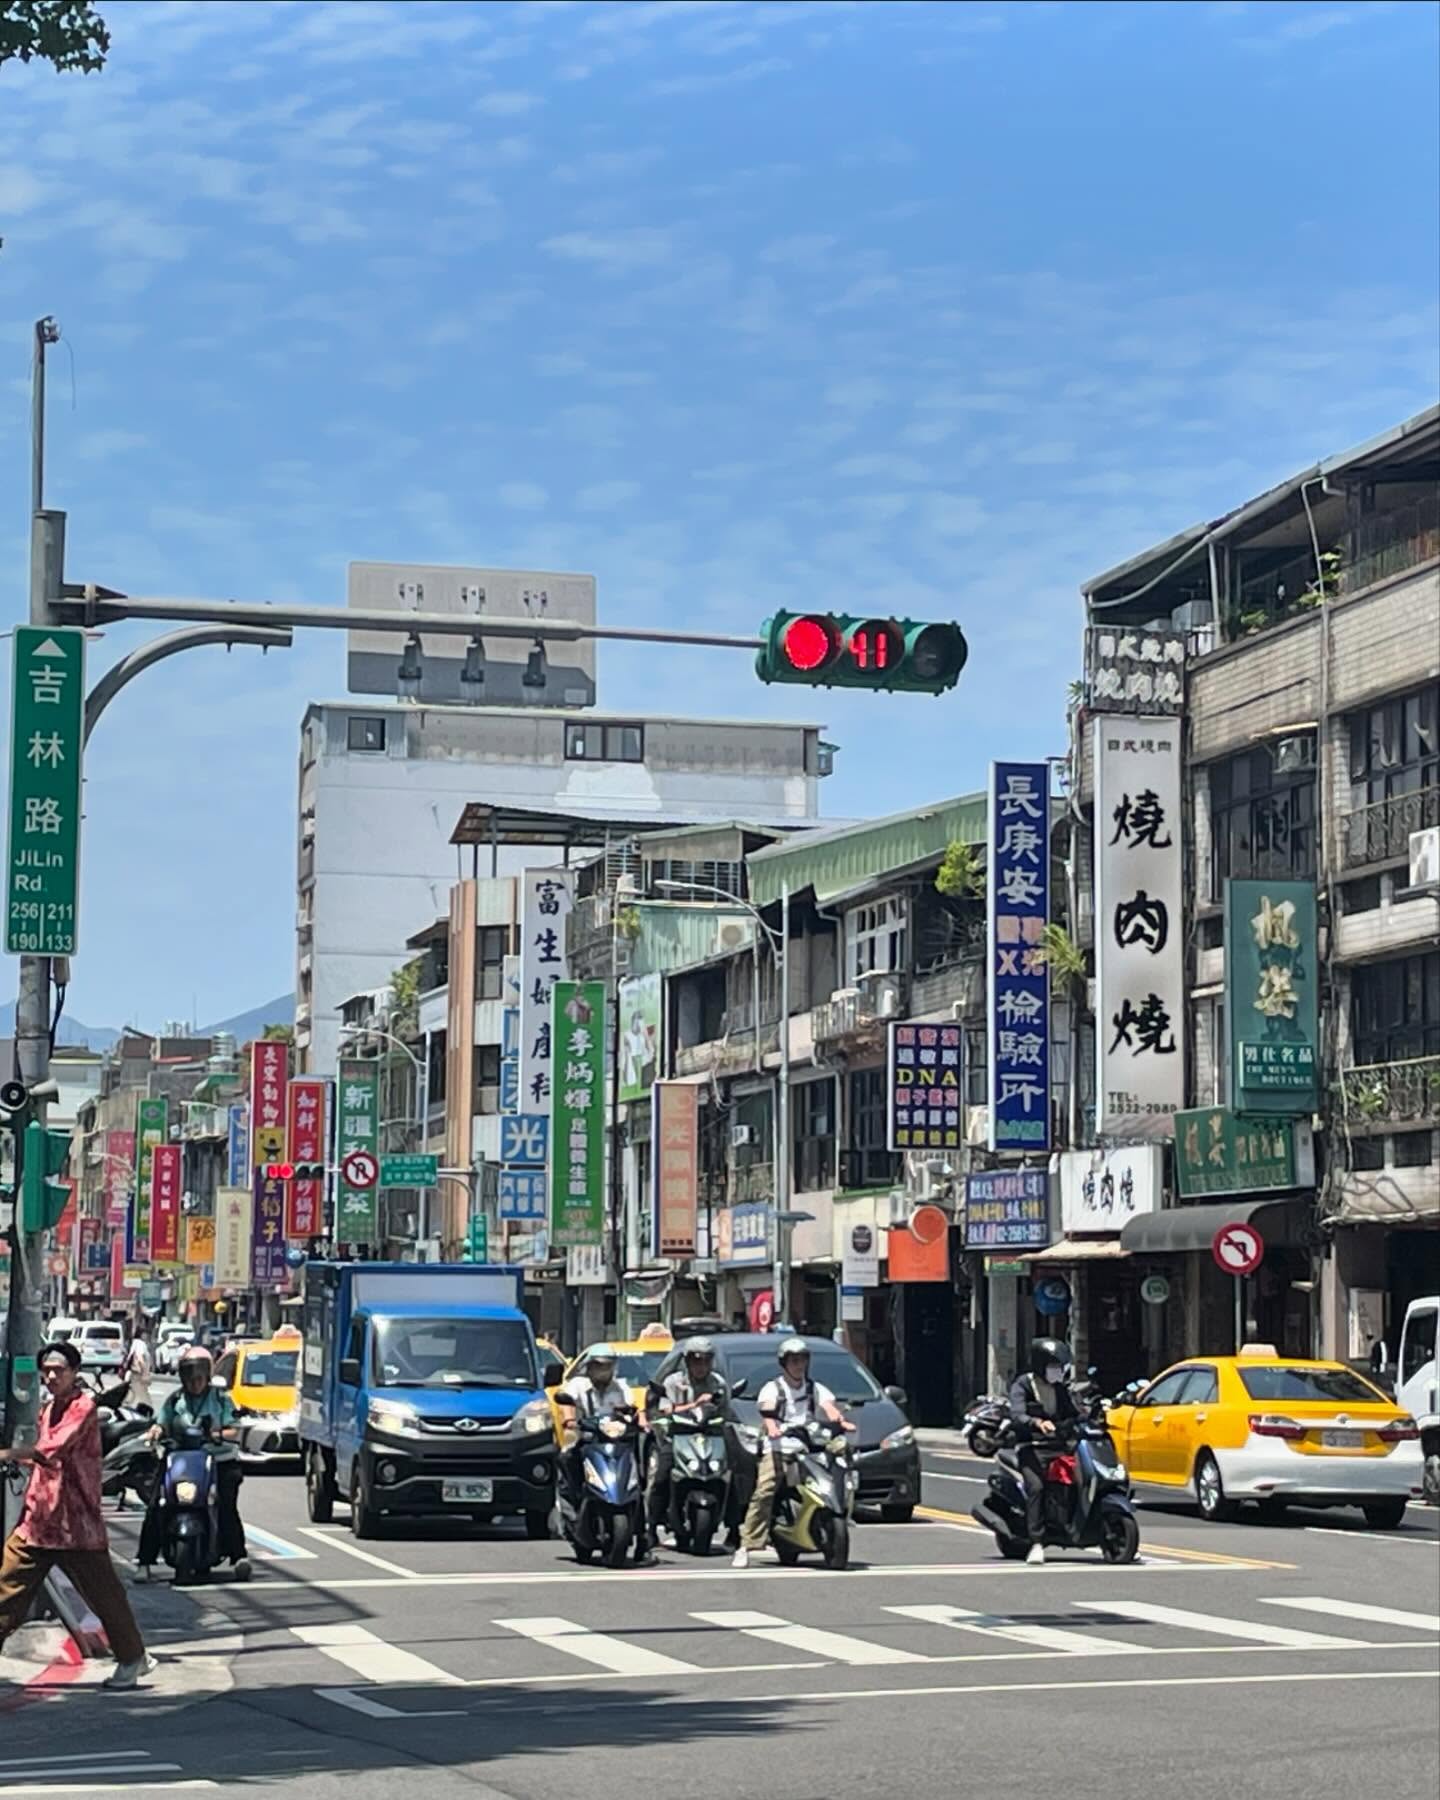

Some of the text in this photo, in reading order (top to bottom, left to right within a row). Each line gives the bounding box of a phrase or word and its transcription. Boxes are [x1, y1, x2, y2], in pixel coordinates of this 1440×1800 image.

[849, 631, 888, 669] 41
[24, 664, 68, 835] 吉林路
[11, 902, 73, 920] 256 211
[1108, 789, 1177, 1055] 燒肉燒
[10, 933, 73, 952] 190 133
[896, 1069, 958, 1086] DNA
